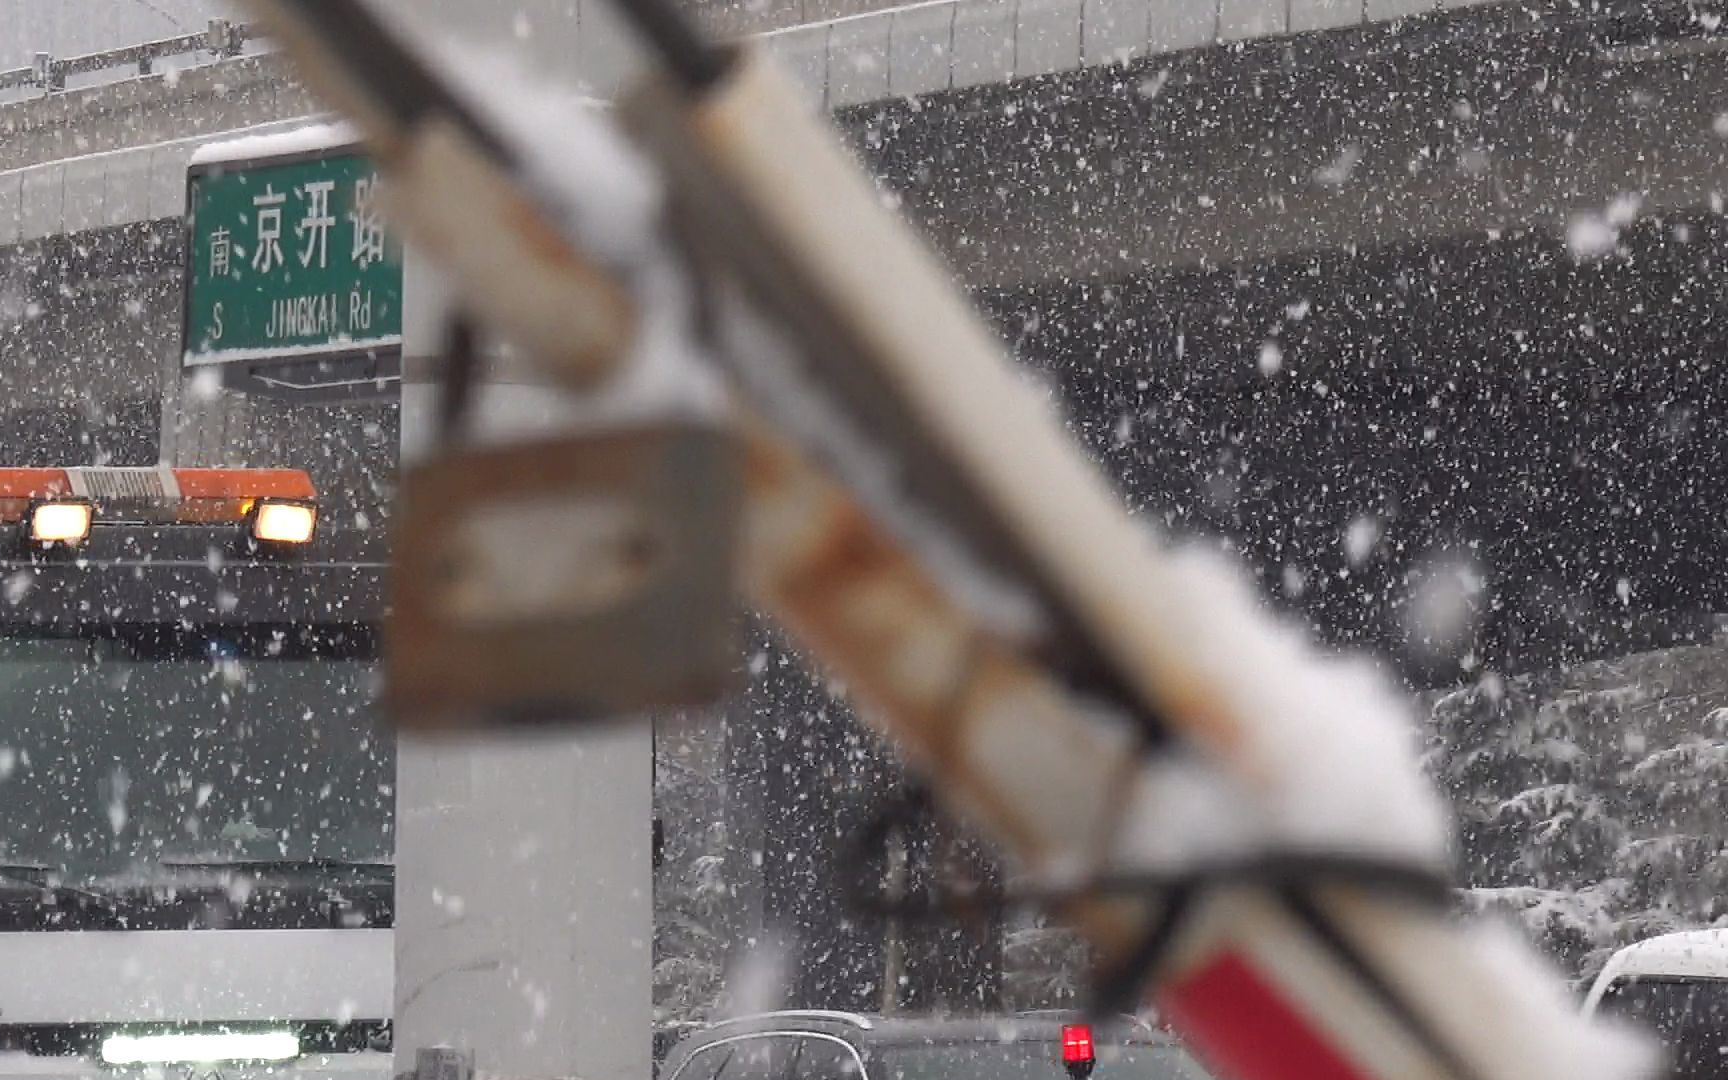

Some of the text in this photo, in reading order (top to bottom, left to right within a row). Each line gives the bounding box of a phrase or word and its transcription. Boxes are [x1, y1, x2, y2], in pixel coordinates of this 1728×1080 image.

[209, 226, 231, 278] 南
[210, 290, 372, 340] S JINGKAI Rd
